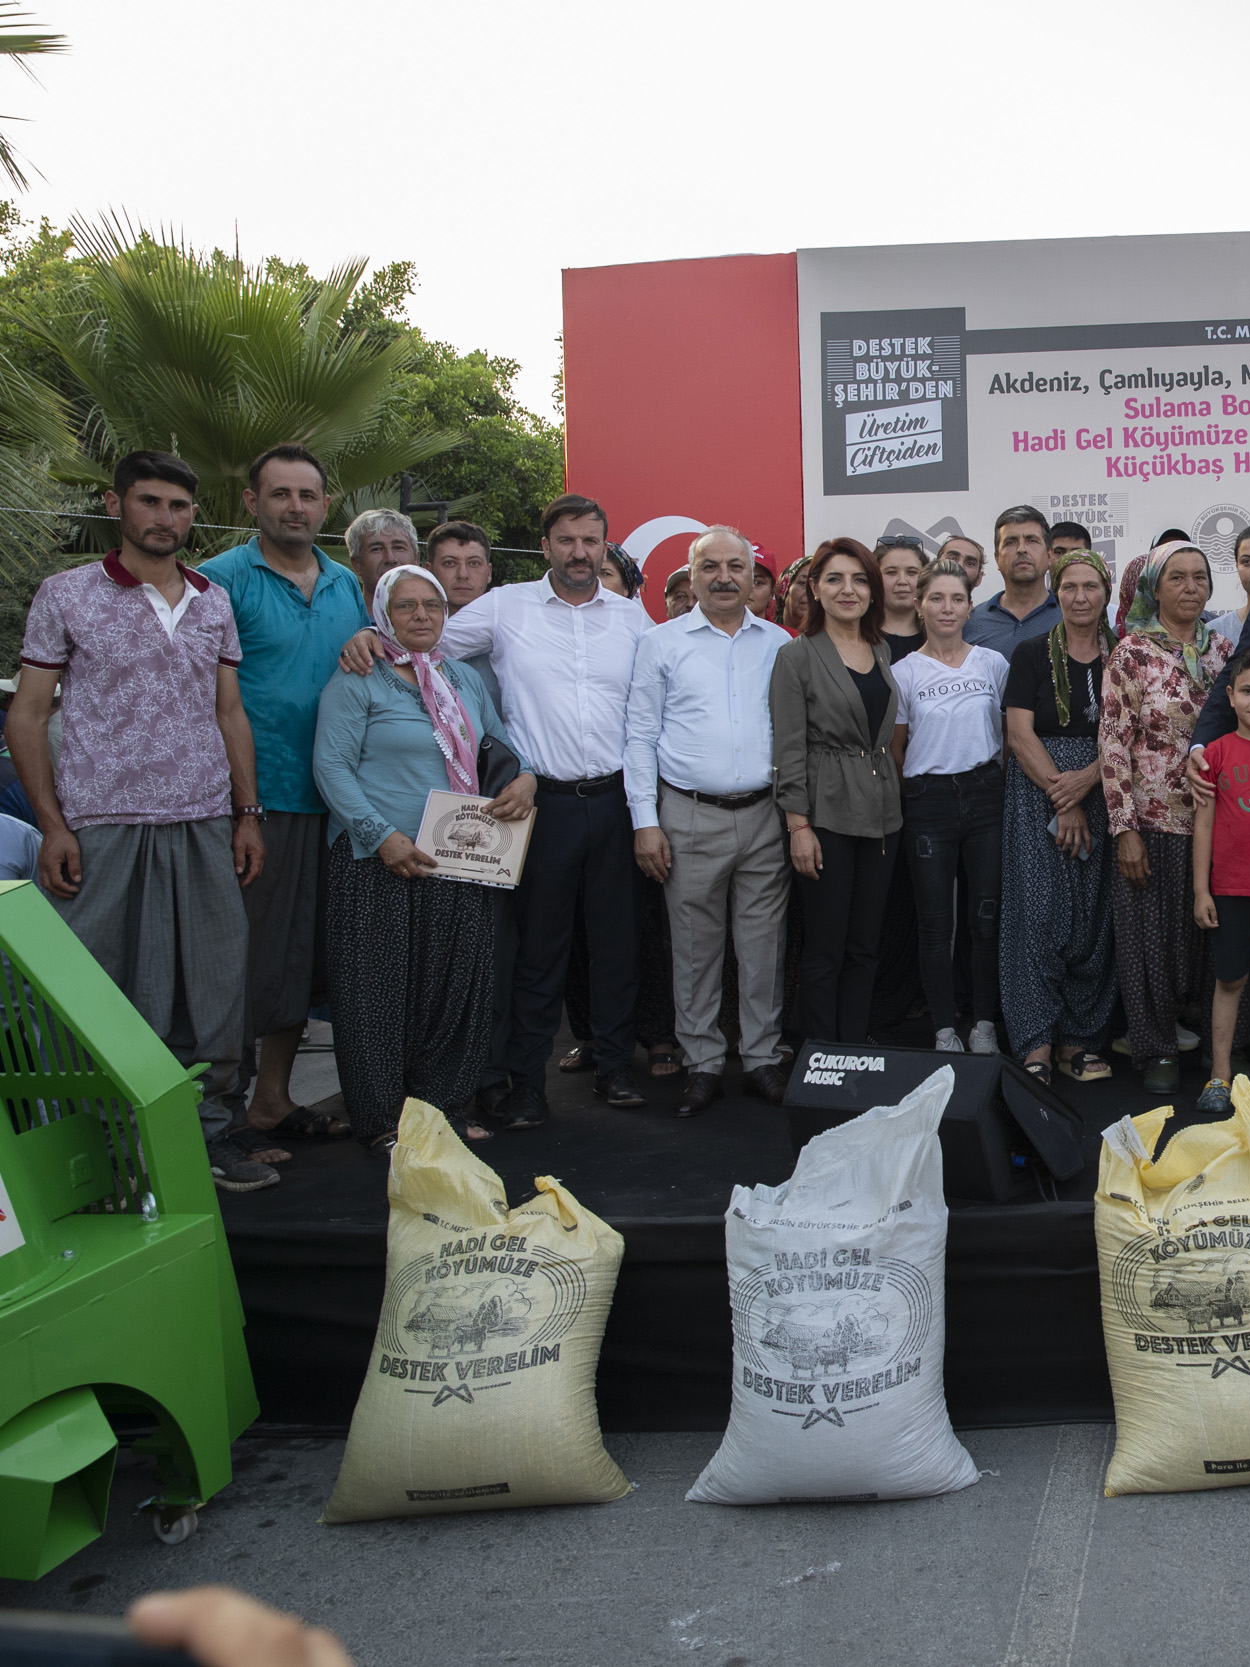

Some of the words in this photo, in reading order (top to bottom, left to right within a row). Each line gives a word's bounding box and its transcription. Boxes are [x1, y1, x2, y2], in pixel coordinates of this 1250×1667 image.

[1205, 325, 1231, 339] T.C.
[852, 337, 932, 357] DESTEK
[856, 357, 939, 380] BÜYÜK-
[989, 371, 1089, 395] Akdeniz,
[1099, 364, 1232, 396] Çamlıyayla,
[834, 380, 953, 408] ŞEHİR'DEN
[1124, 397, 1211, 420] Sulama
[859, 412, 929, 439] Üretim
[1013, 428, 1066, 452] Hadi
[1076, 427, 1113, 451] Gel
[1123, 423, 1248, 453] Köyümüze
[850, 439, 941, 473] Çiftçiden
[1105, 453, 1224, 483] Küçükbaş
[1050, 493, 1108, 507] DESTEK
[1053, 509, 1114, 524] BÜYÜK-
[455, 811, 496, 828] KÖYÜMÜZE
[434, 848, 463, 860] DESTEK
[465, 852, 501, 865] VERELİM
[808, 1052, 885, 1072] ÇUKUROVA
[803, 1070, 845, 1086] MUSIC
[440, 1232, 487, 1259] HADİ
[490, 1234, 527, 1252] GEL
[425, 1253, 540, 1284] KÖYÜMÜZE
[774, 1248, 827, 1271] HADİ
[832, 1248, 872, 1268] GEL
[764, 1268, 885, 1298] KÖYÜMÜZE
[1134, 1333, 1219, 1354] DESTEK
[380, 1354, 449, 1382] DESTEK
[455, 1343, 561, 1381] VERELİM
[743, 1366, 815, 1405] DESTEK
[821, 1357, 921, 1404] VERELİM
